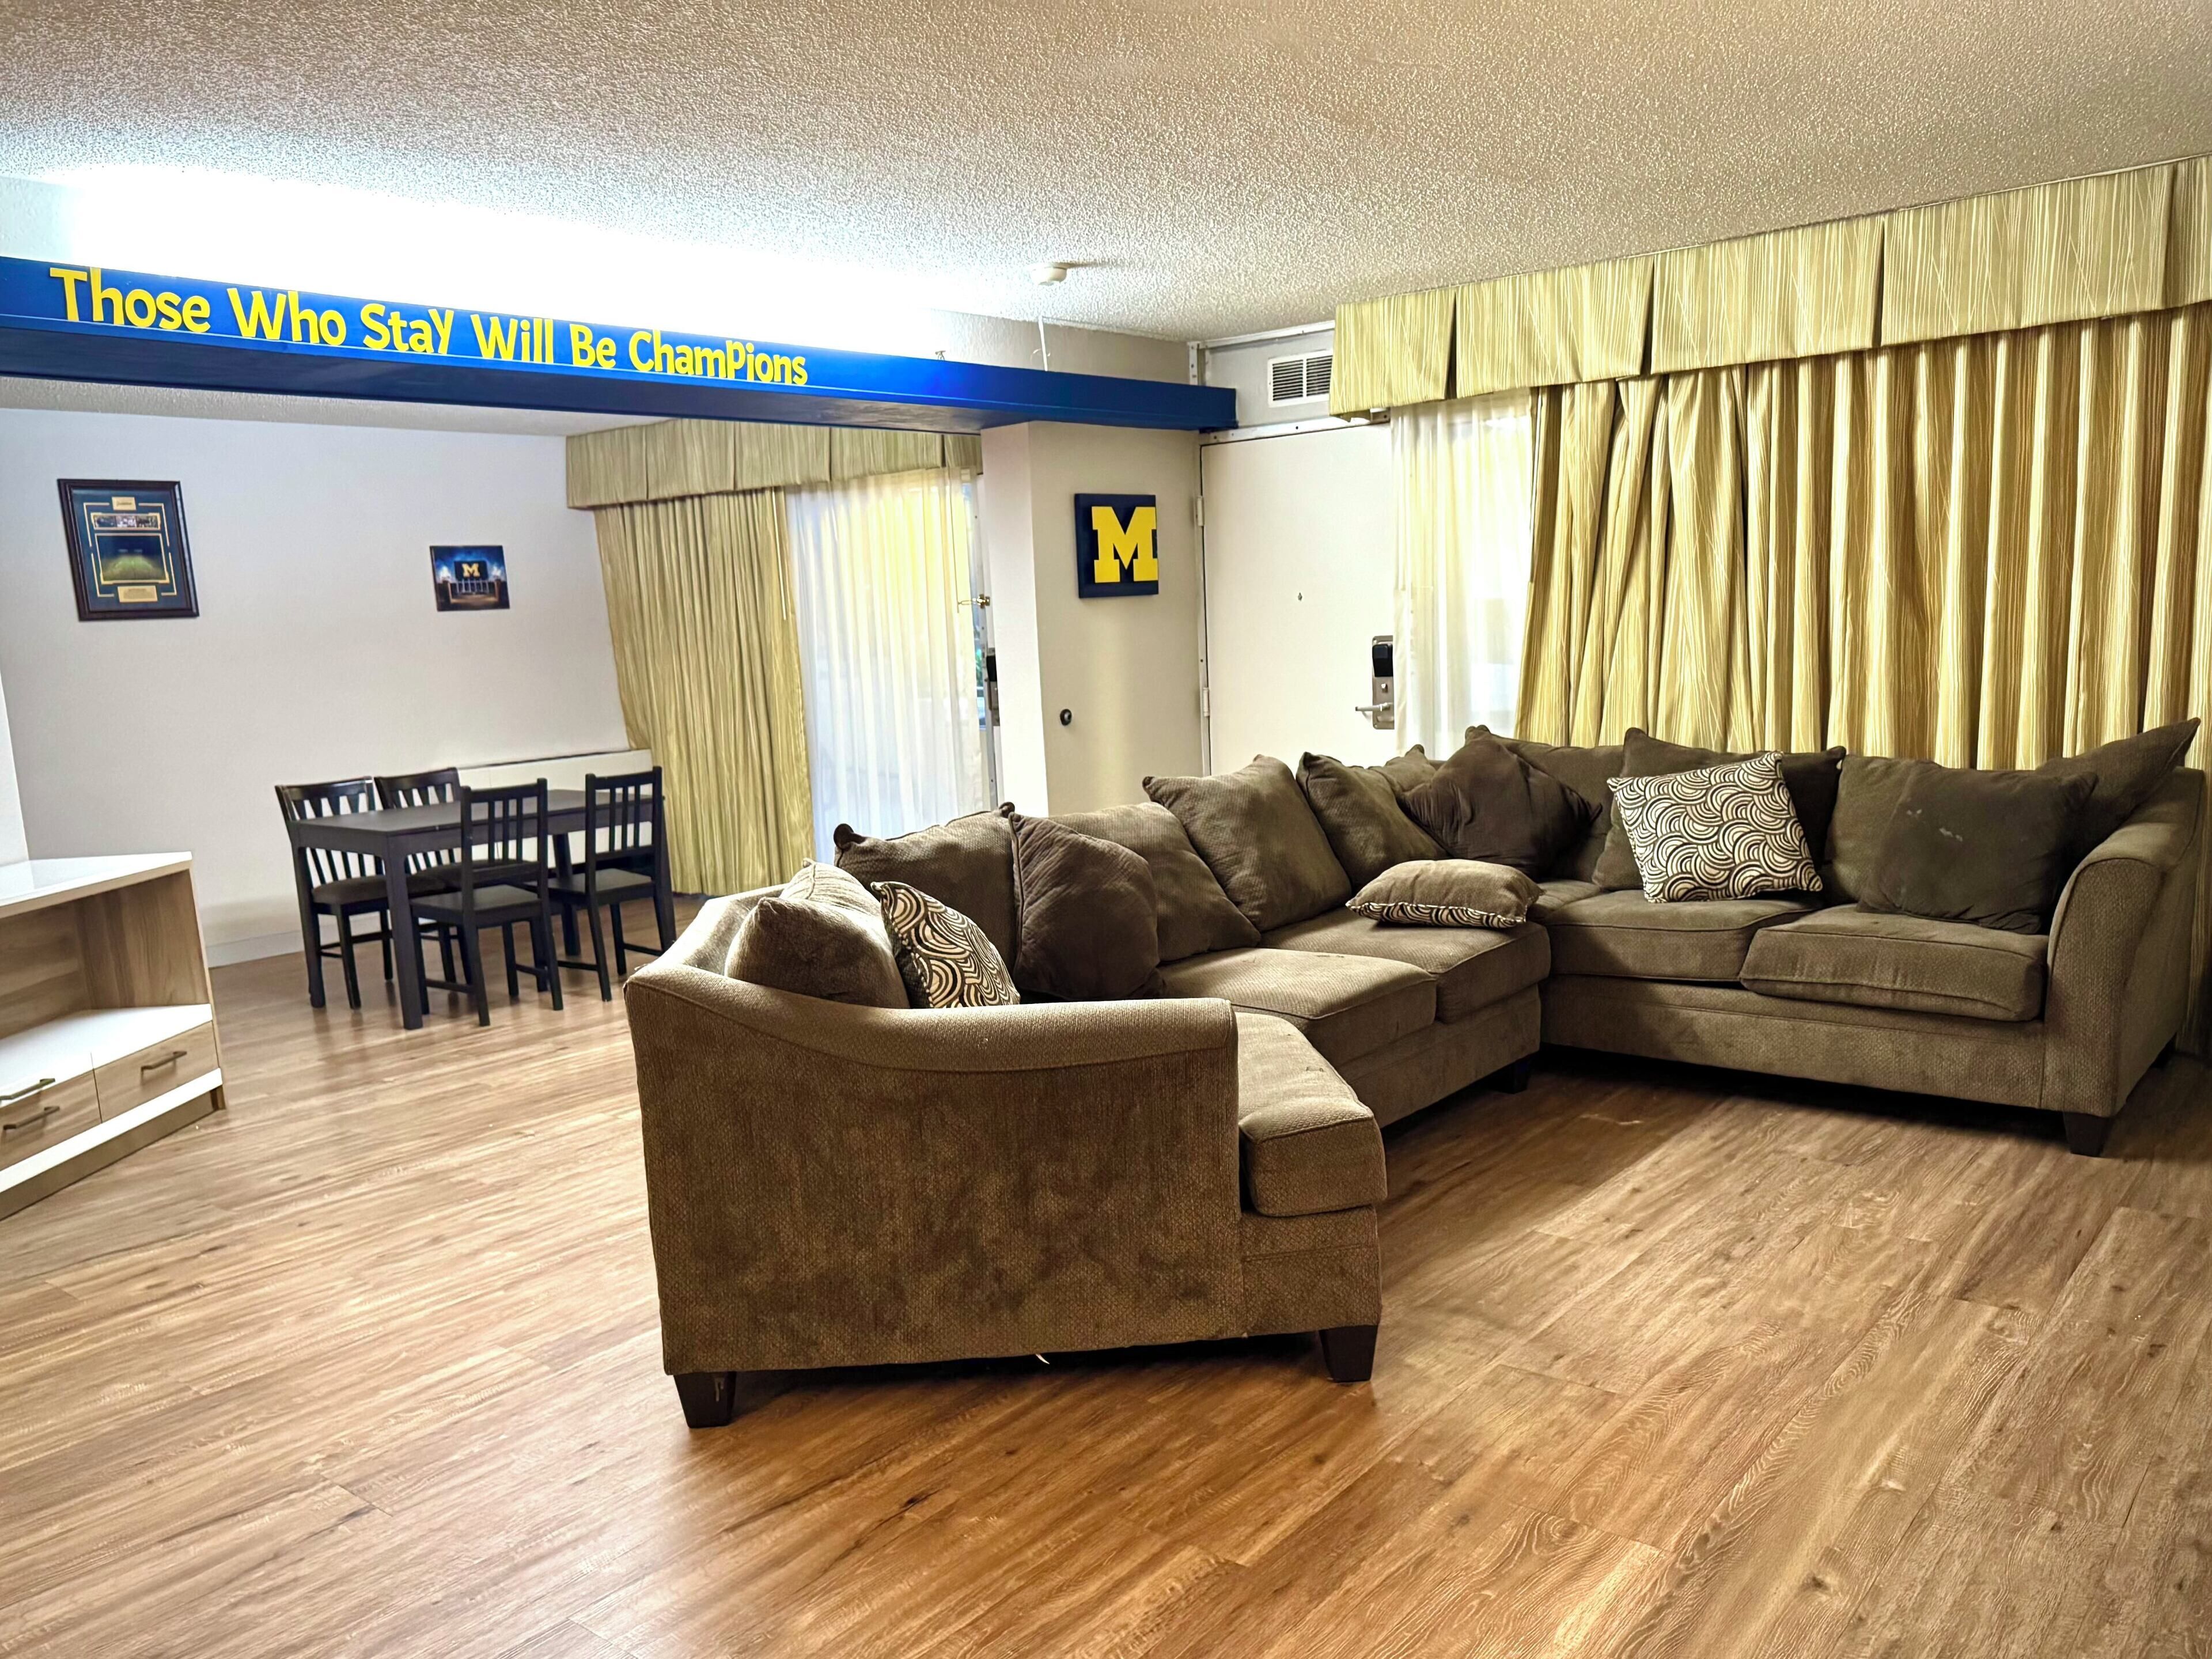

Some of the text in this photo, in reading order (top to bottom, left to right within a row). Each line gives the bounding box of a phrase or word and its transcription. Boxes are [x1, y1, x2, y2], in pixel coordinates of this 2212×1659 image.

[50, 267, 211, 334] Those
[227, 288, 347, 346] Who
[470, 316, 554, 363] Will
[570, 324, 616, 369] Be
[462, 563, 480, 578] M
[1092, 506, 1158, 583] M
